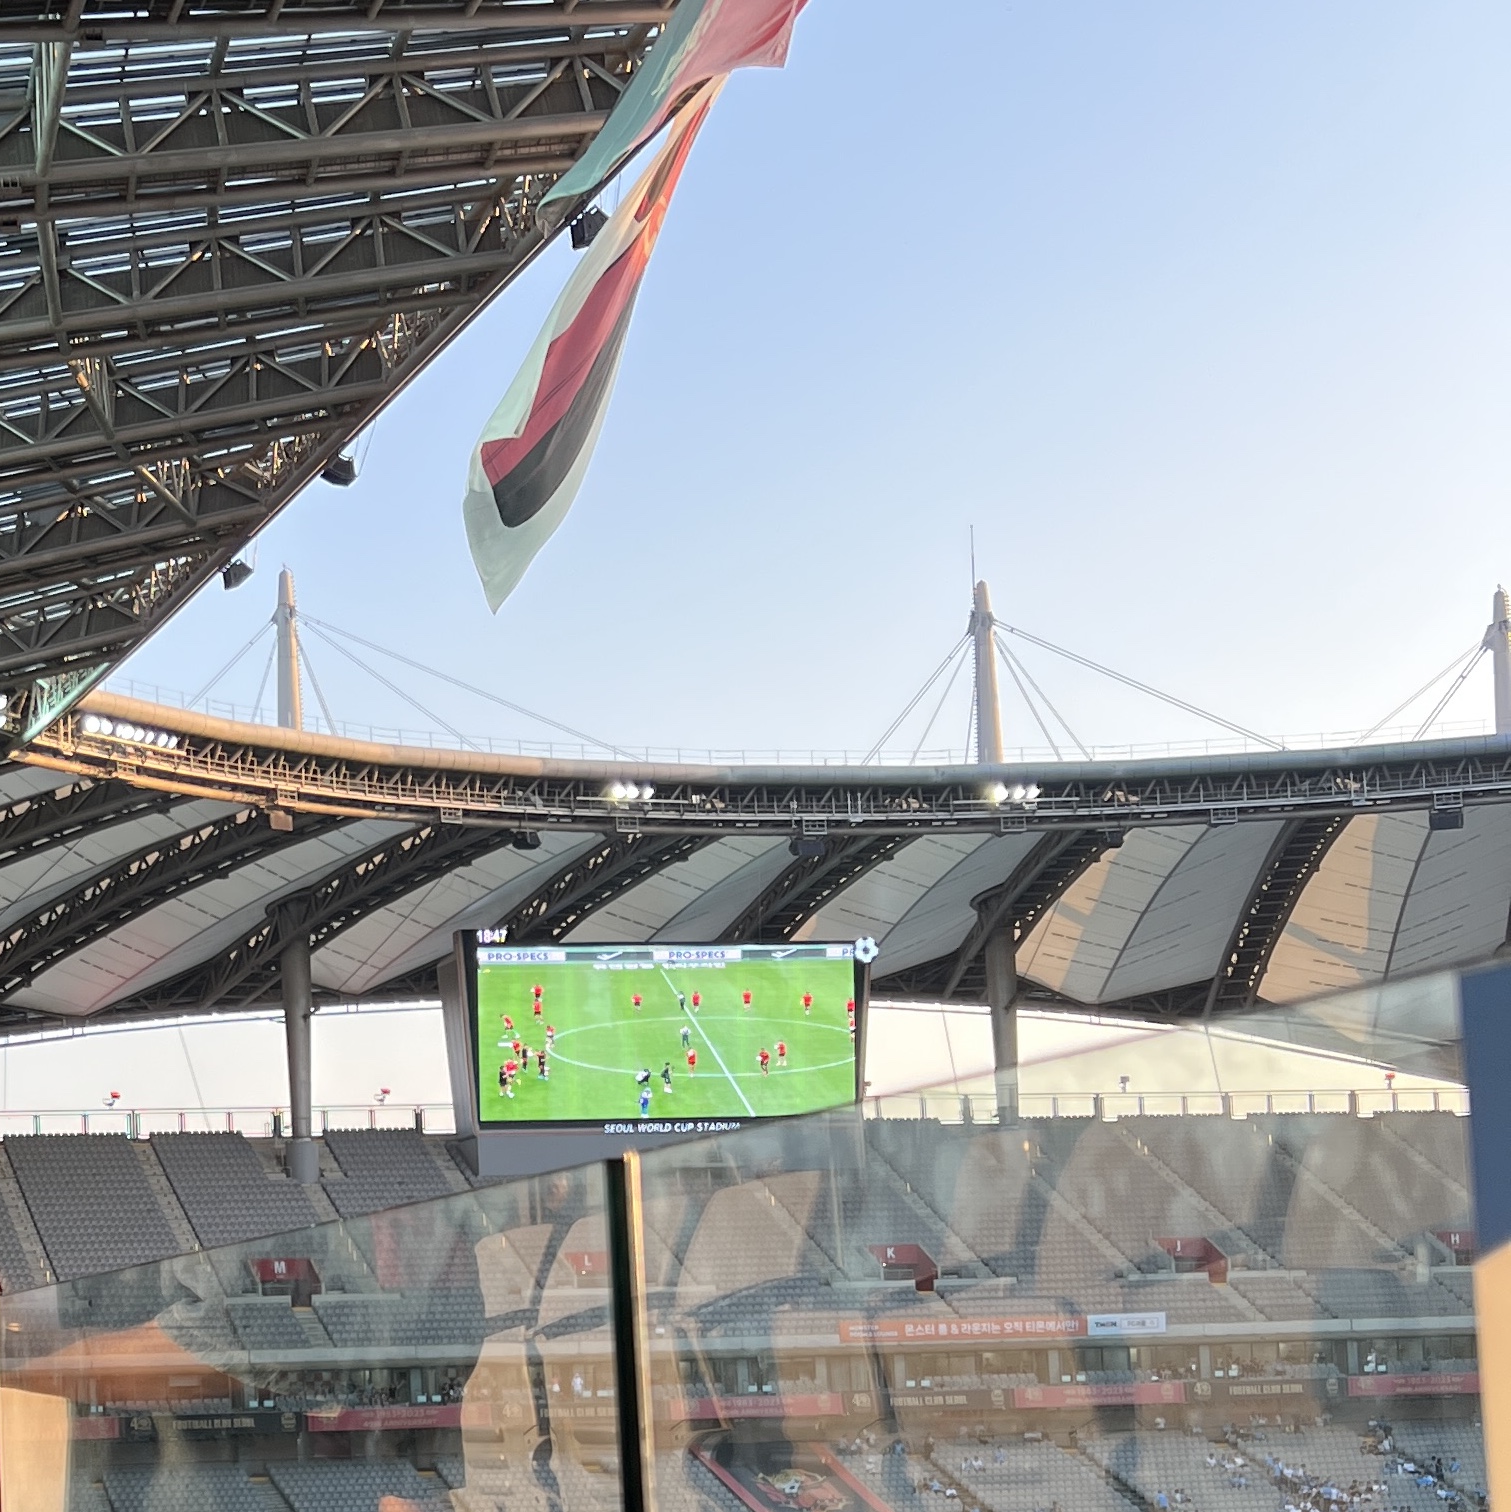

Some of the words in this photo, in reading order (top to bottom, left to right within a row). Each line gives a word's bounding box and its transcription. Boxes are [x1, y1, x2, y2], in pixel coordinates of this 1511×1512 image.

[669, 951, 725, 959] PRO-SPECS
[604, 1123, 634, 1133] SEOUL
[638, 1122, 672, 1133] WORLD
[674, 1122, 695, 1132] CUP
[274, 1261, 286, 1273] M
